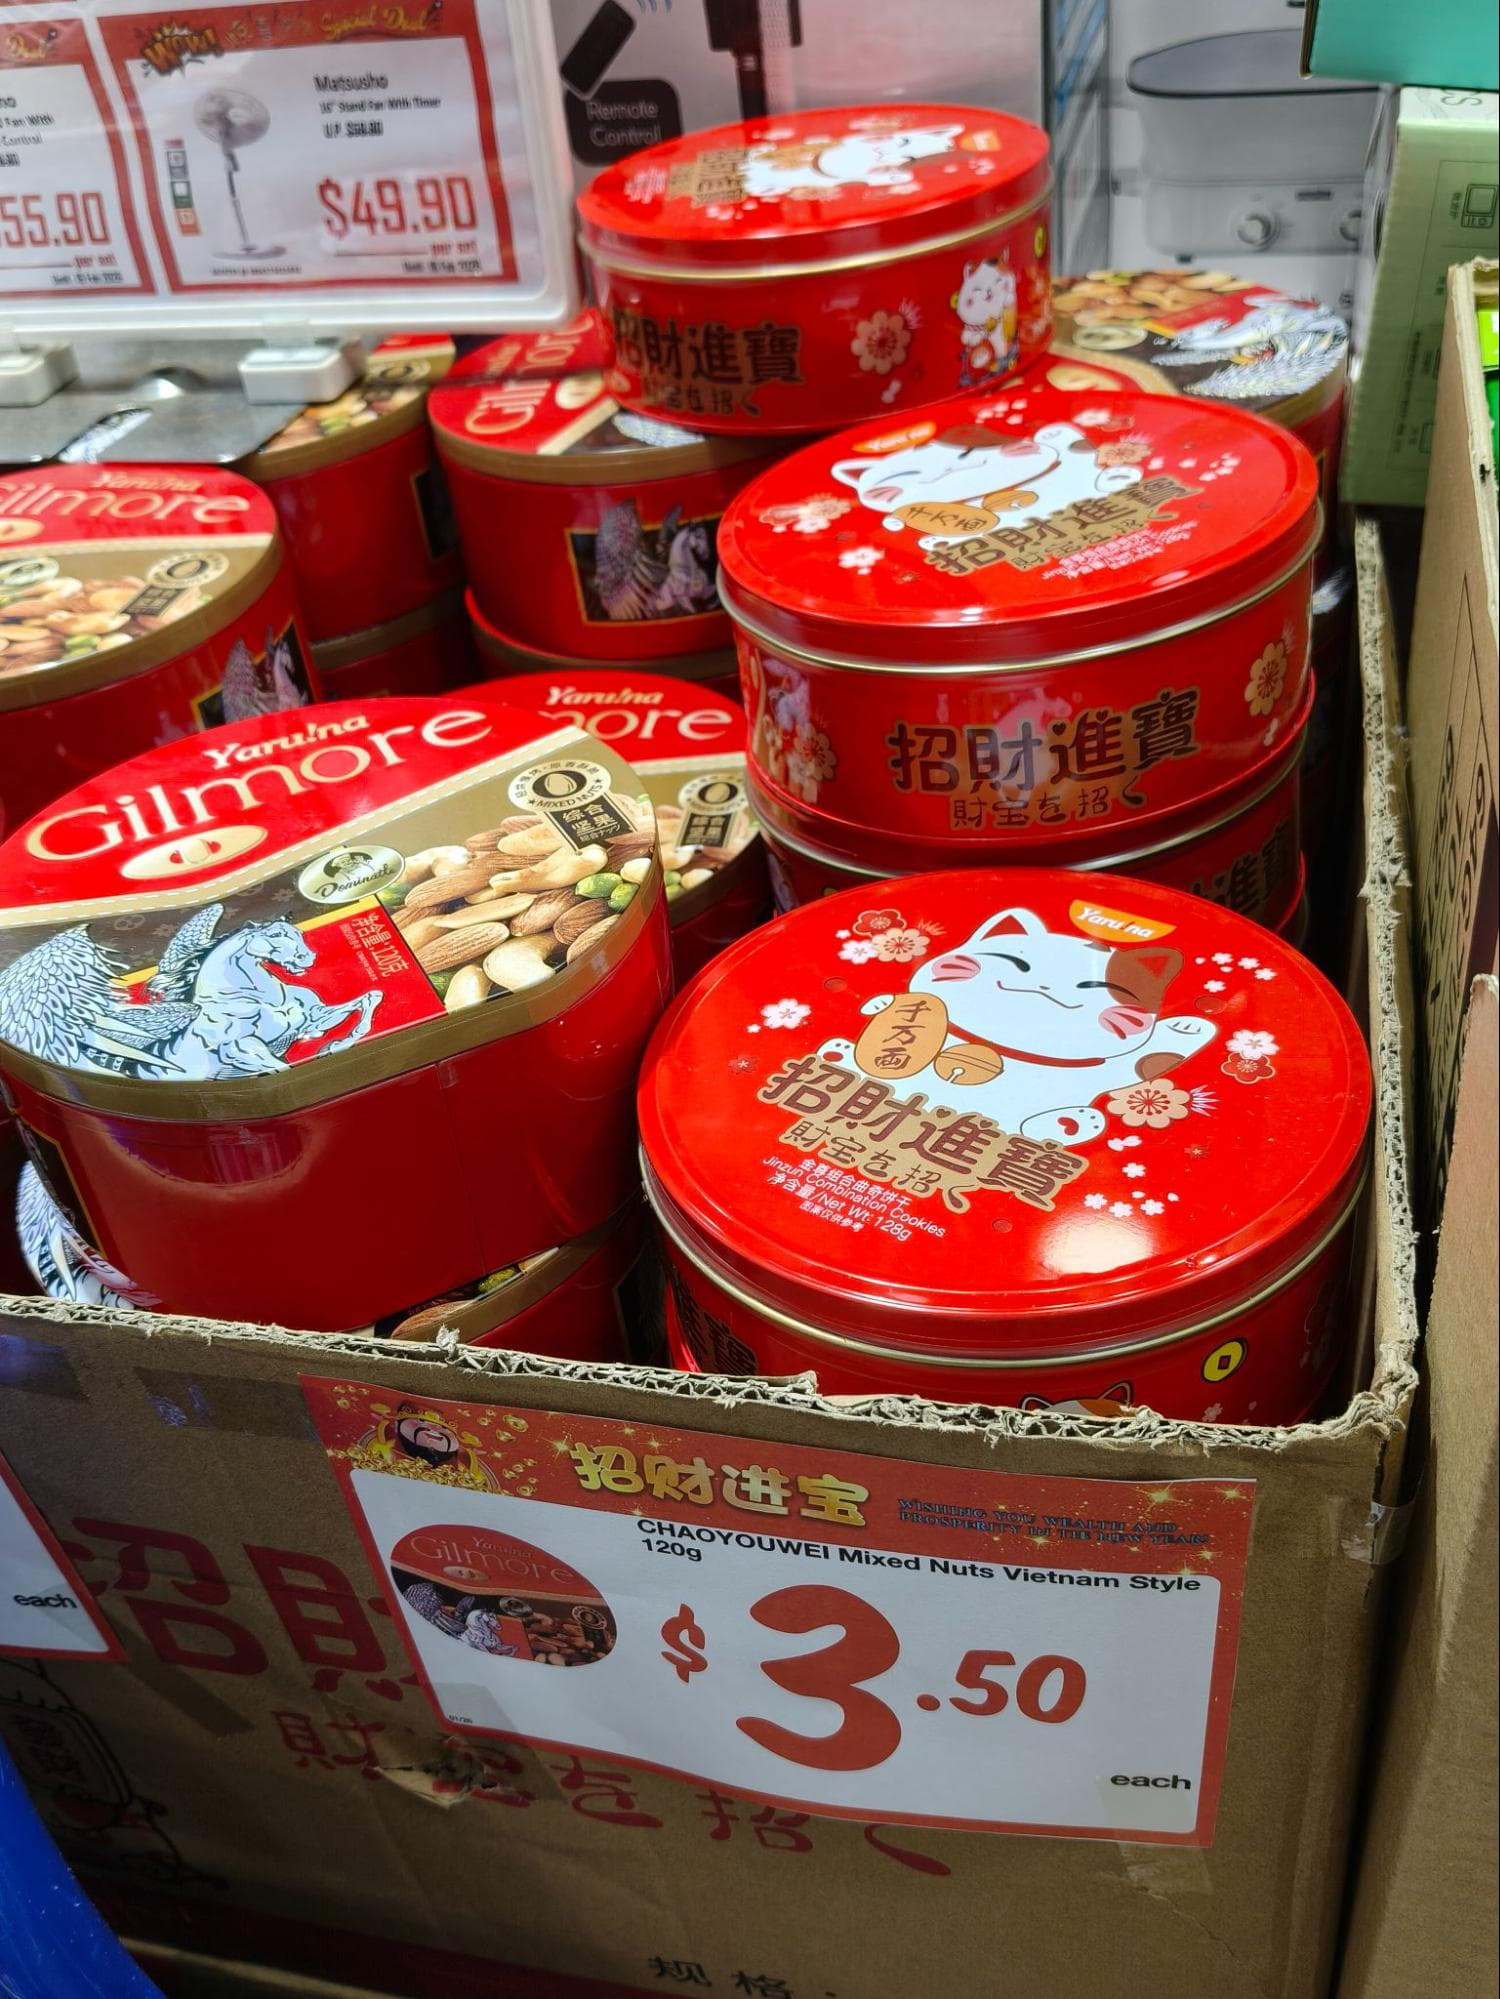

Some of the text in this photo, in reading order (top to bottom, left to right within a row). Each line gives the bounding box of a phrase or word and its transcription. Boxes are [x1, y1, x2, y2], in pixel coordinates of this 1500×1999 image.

[586, 100, 658, 120] Remote
[590, 124, 661, 147] Control
[317, 175, 478, 239] $49.90
[0, 481, 249, 523] ilmore
[203, 713, 373, 770] Yaru!na
[888, 689, 1199, 794] 招財進寶
[24, 708, 495, 863] Gilmore
[536, 784, 603, 809] MIXED NUTS
[952, 775, 1148, 828] 財宝を招く
[1076, 906, 1157, 939] Yaru!na
[762, 1056, 1084, 1208] 招財進寶
[783, 1121, 976, 1210] 財宝を招く
[801, 1158, 912, 1208] 金尊组合曲奇饼干
[763, 1155, 947, 1238] Jinzun Combination Cookies
[874, 1216, 912, 1242] 128g
[571, 1441, 870, 1527] 招财进宝
[898, 1498, 1178, 1533] WISHING YOU WEALTH AND
[899, 1511, 1021, 1535] PROSPERITY
[1097, 1531, 1142, 1544] NEW
[410, 1535, 577, 1584] Gilmore
[636, 1518, 1201, 1594] CHAOYOUWEI Mixed Nuts Vietnam Style
[641, 1538, 703, 1564] 120g
[13, 1593, 78, 1609] each
[1110, 1770, 1192, 1791] each
